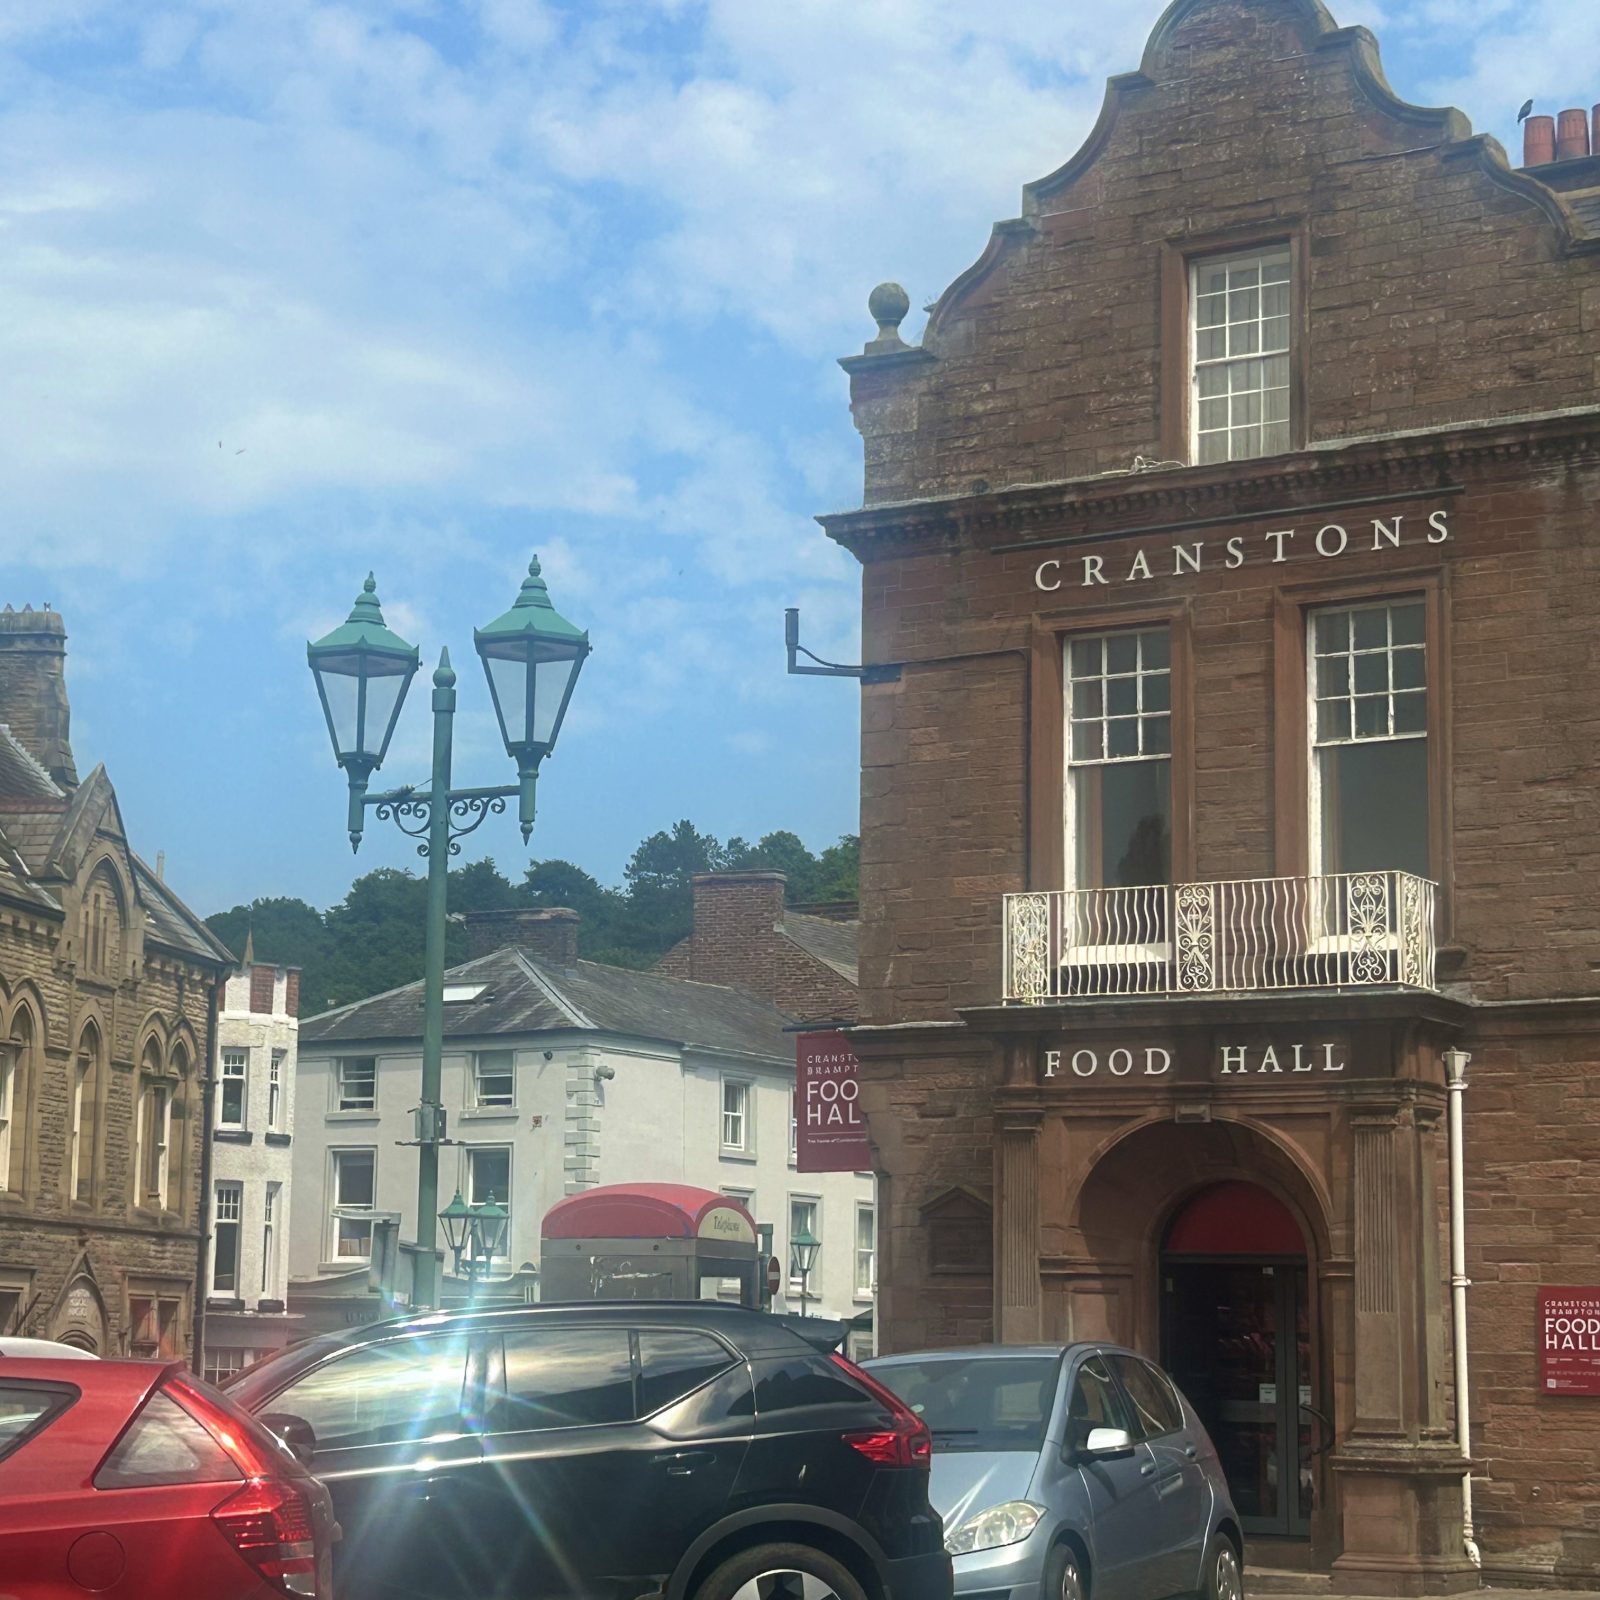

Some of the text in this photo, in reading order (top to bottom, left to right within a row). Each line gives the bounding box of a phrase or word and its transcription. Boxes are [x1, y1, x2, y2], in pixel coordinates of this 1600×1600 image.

[1035, 510, 1449, 592] CRANSTONS
[1044, 1043, 1345, 1078] FOOD HALL
[806, 1079, 859, 1103] FOO
[806, 1102, 862, 1126] HAL
[1544, 1318, 1600, 1334] FOOD
[1544, 1334, 1600, 1350] HALL
